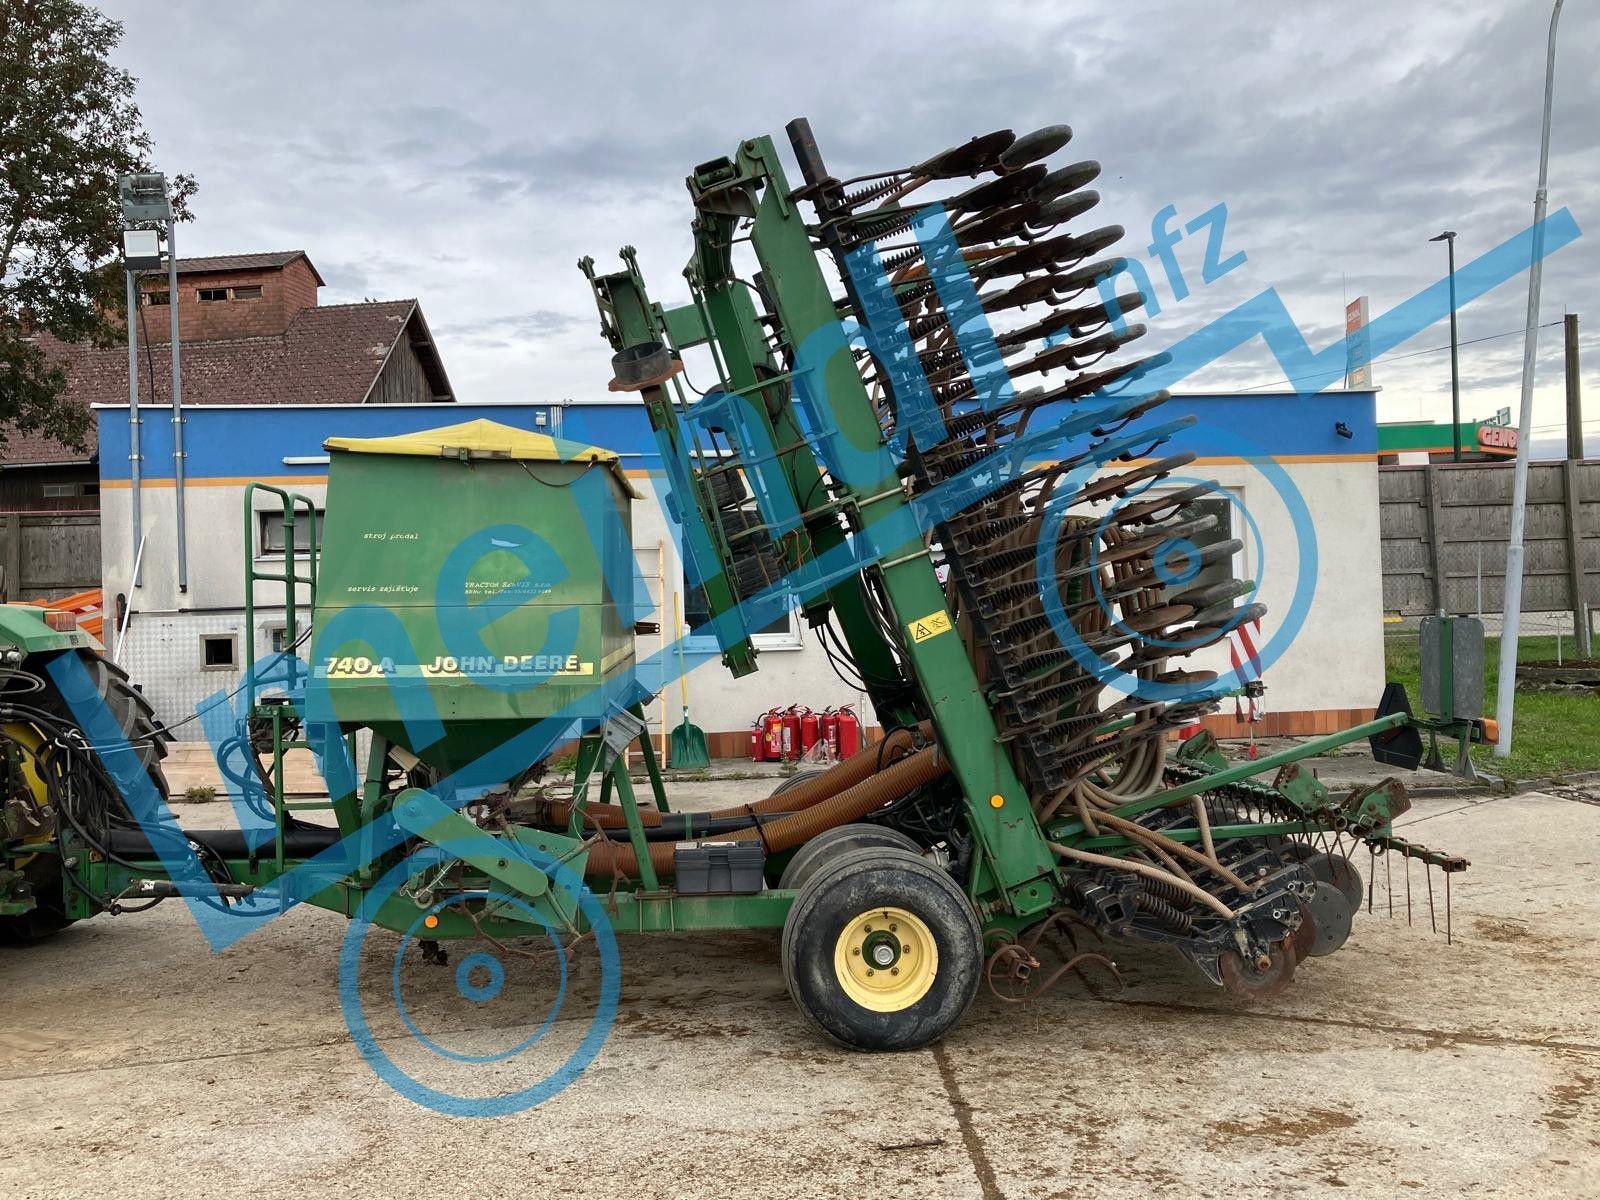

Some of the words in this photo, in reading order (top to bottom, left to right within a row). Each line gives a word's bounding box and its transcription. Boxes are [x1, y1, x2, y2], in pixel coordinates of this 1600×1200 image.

[325, 656, 372, 674] 740
[376, 657, 396, 674] A
[427, 656, 496, 674] JOHN
[503, 655, 580, 673] DEERE
